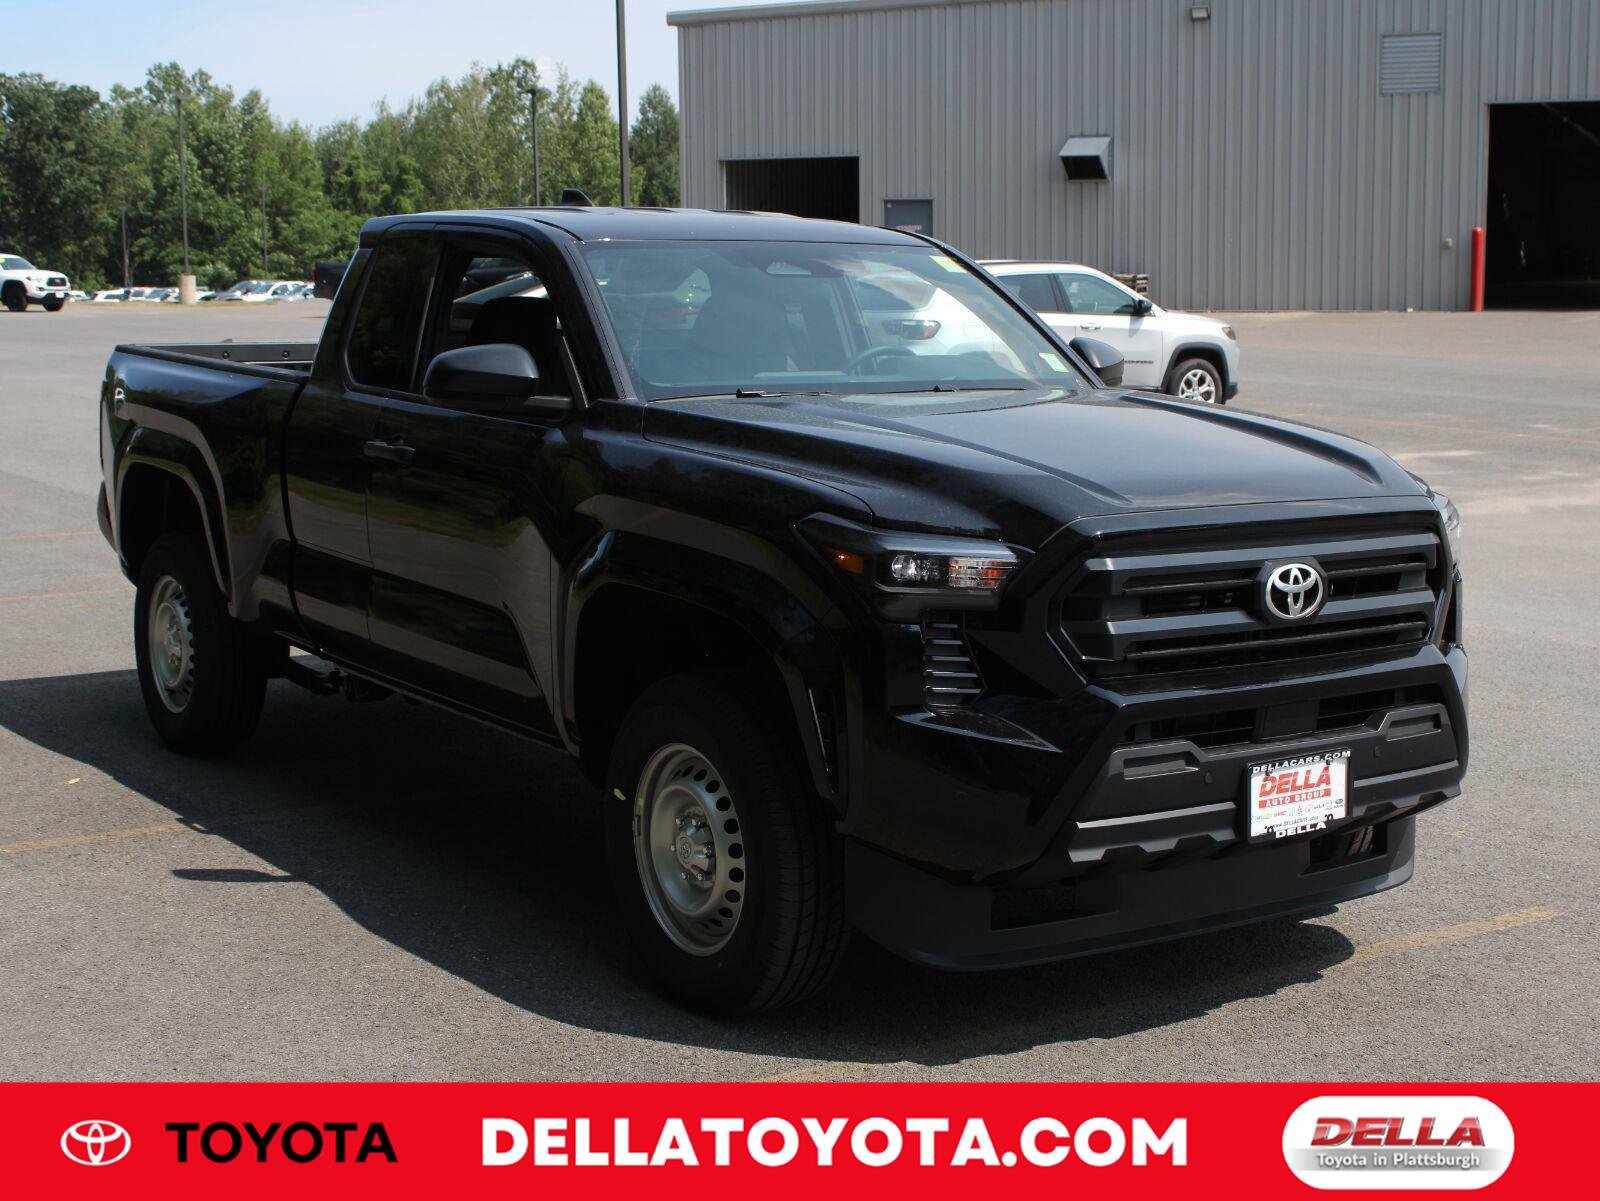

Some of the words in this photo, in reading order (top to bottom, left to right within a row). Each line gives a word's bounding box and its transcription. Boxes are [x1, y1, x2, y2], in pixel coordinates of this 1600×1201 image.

[1252, 750, 1351, 774] DELLACARS.COM
[1259, 765, 1332, 798] DELLA
[1265, 796, 1291, 808] AUTO
[1295, 790, 1325, 803] GROUP
[1275, 821, 1327, 839] DELLA
